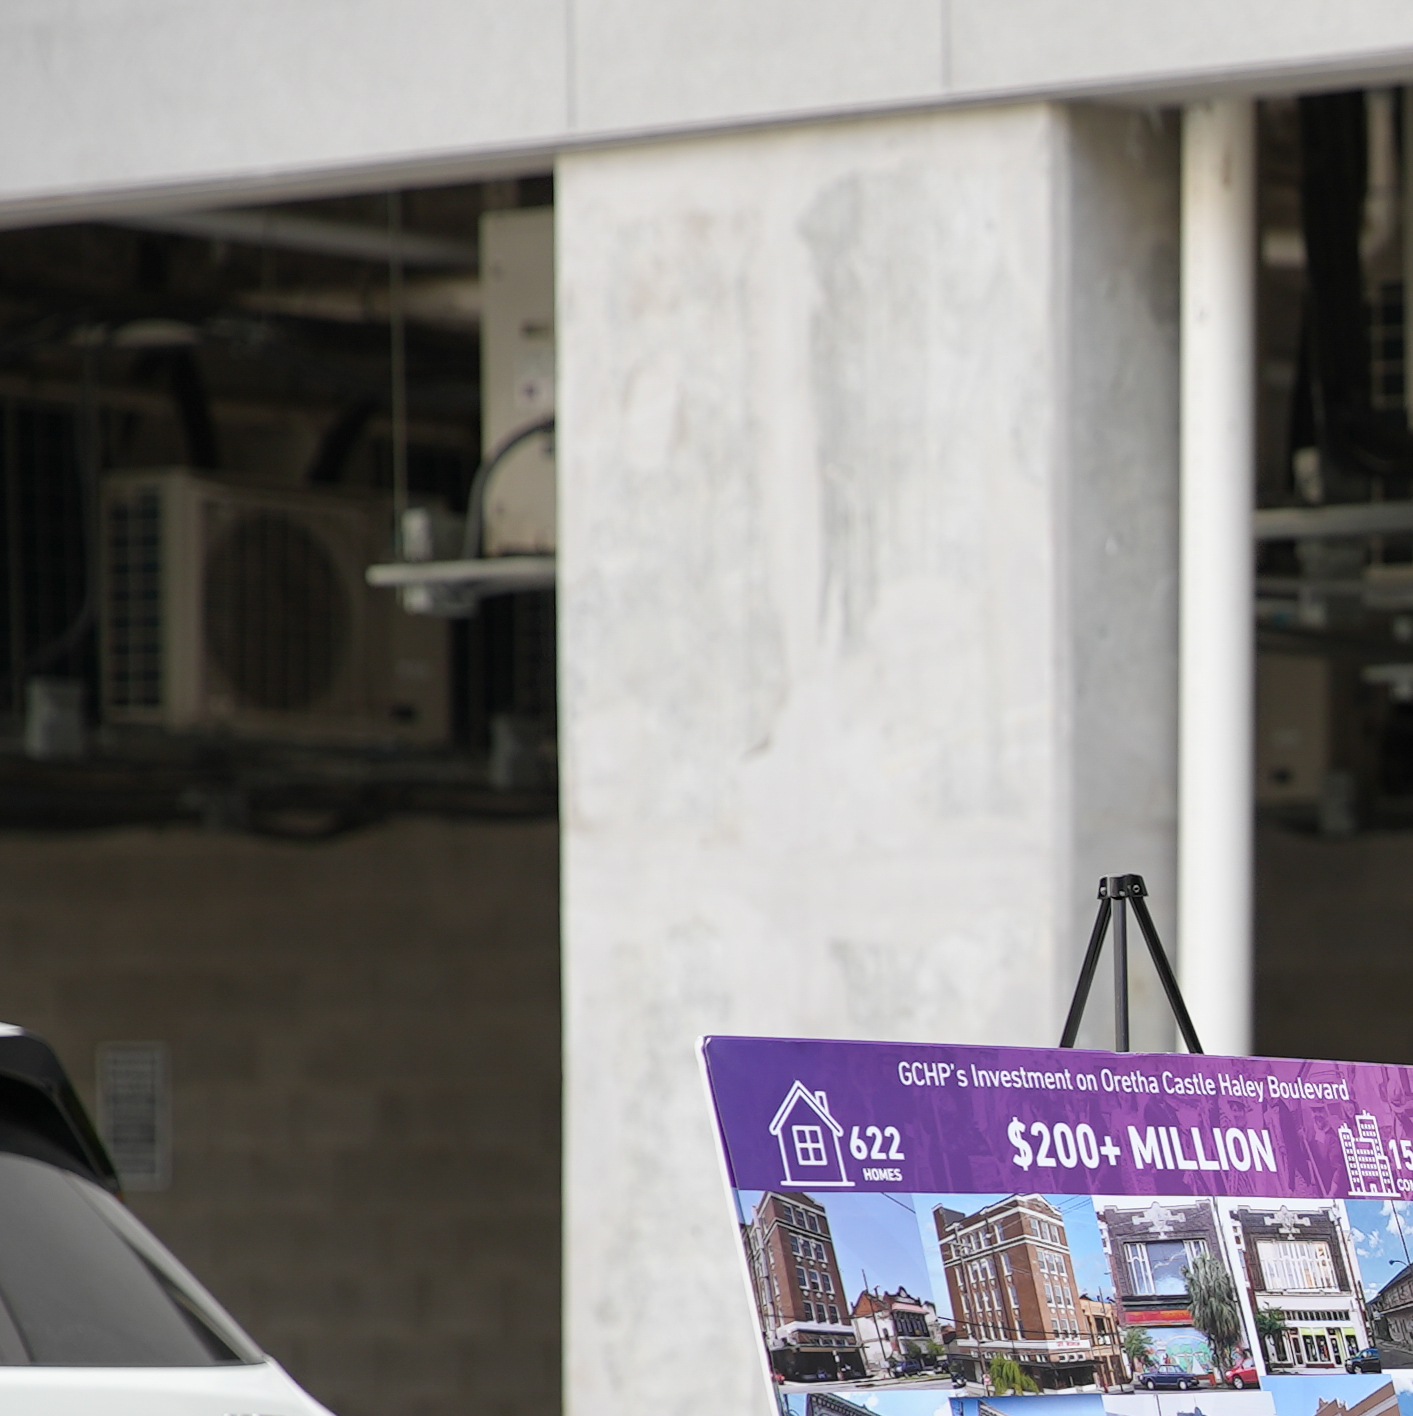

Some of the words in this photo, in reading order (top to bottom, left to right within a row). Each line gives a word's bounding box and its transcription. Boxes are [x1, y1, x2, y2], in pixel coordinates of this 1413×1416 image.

[898, 1061, 968, 1087] GCHP's
[971, 1064, 1073, 1090] Investment
[1076, 1072, 1099, 1091] on
[1101, 1068, 1159, 1093] Oretha
[1162, 1071, 1216, 1096] Castle
[1218, 1074, 1264, 1102] Haley
[1267, 1076, 1350, 1100] Boulevard
[849, 1125, 905, 1160] 622
[1007, 1117, 1121, 1171] $200+
[1127, 1124, 1277, 1173] MILLION
[863, 1167, 902, 1182] HOMES
